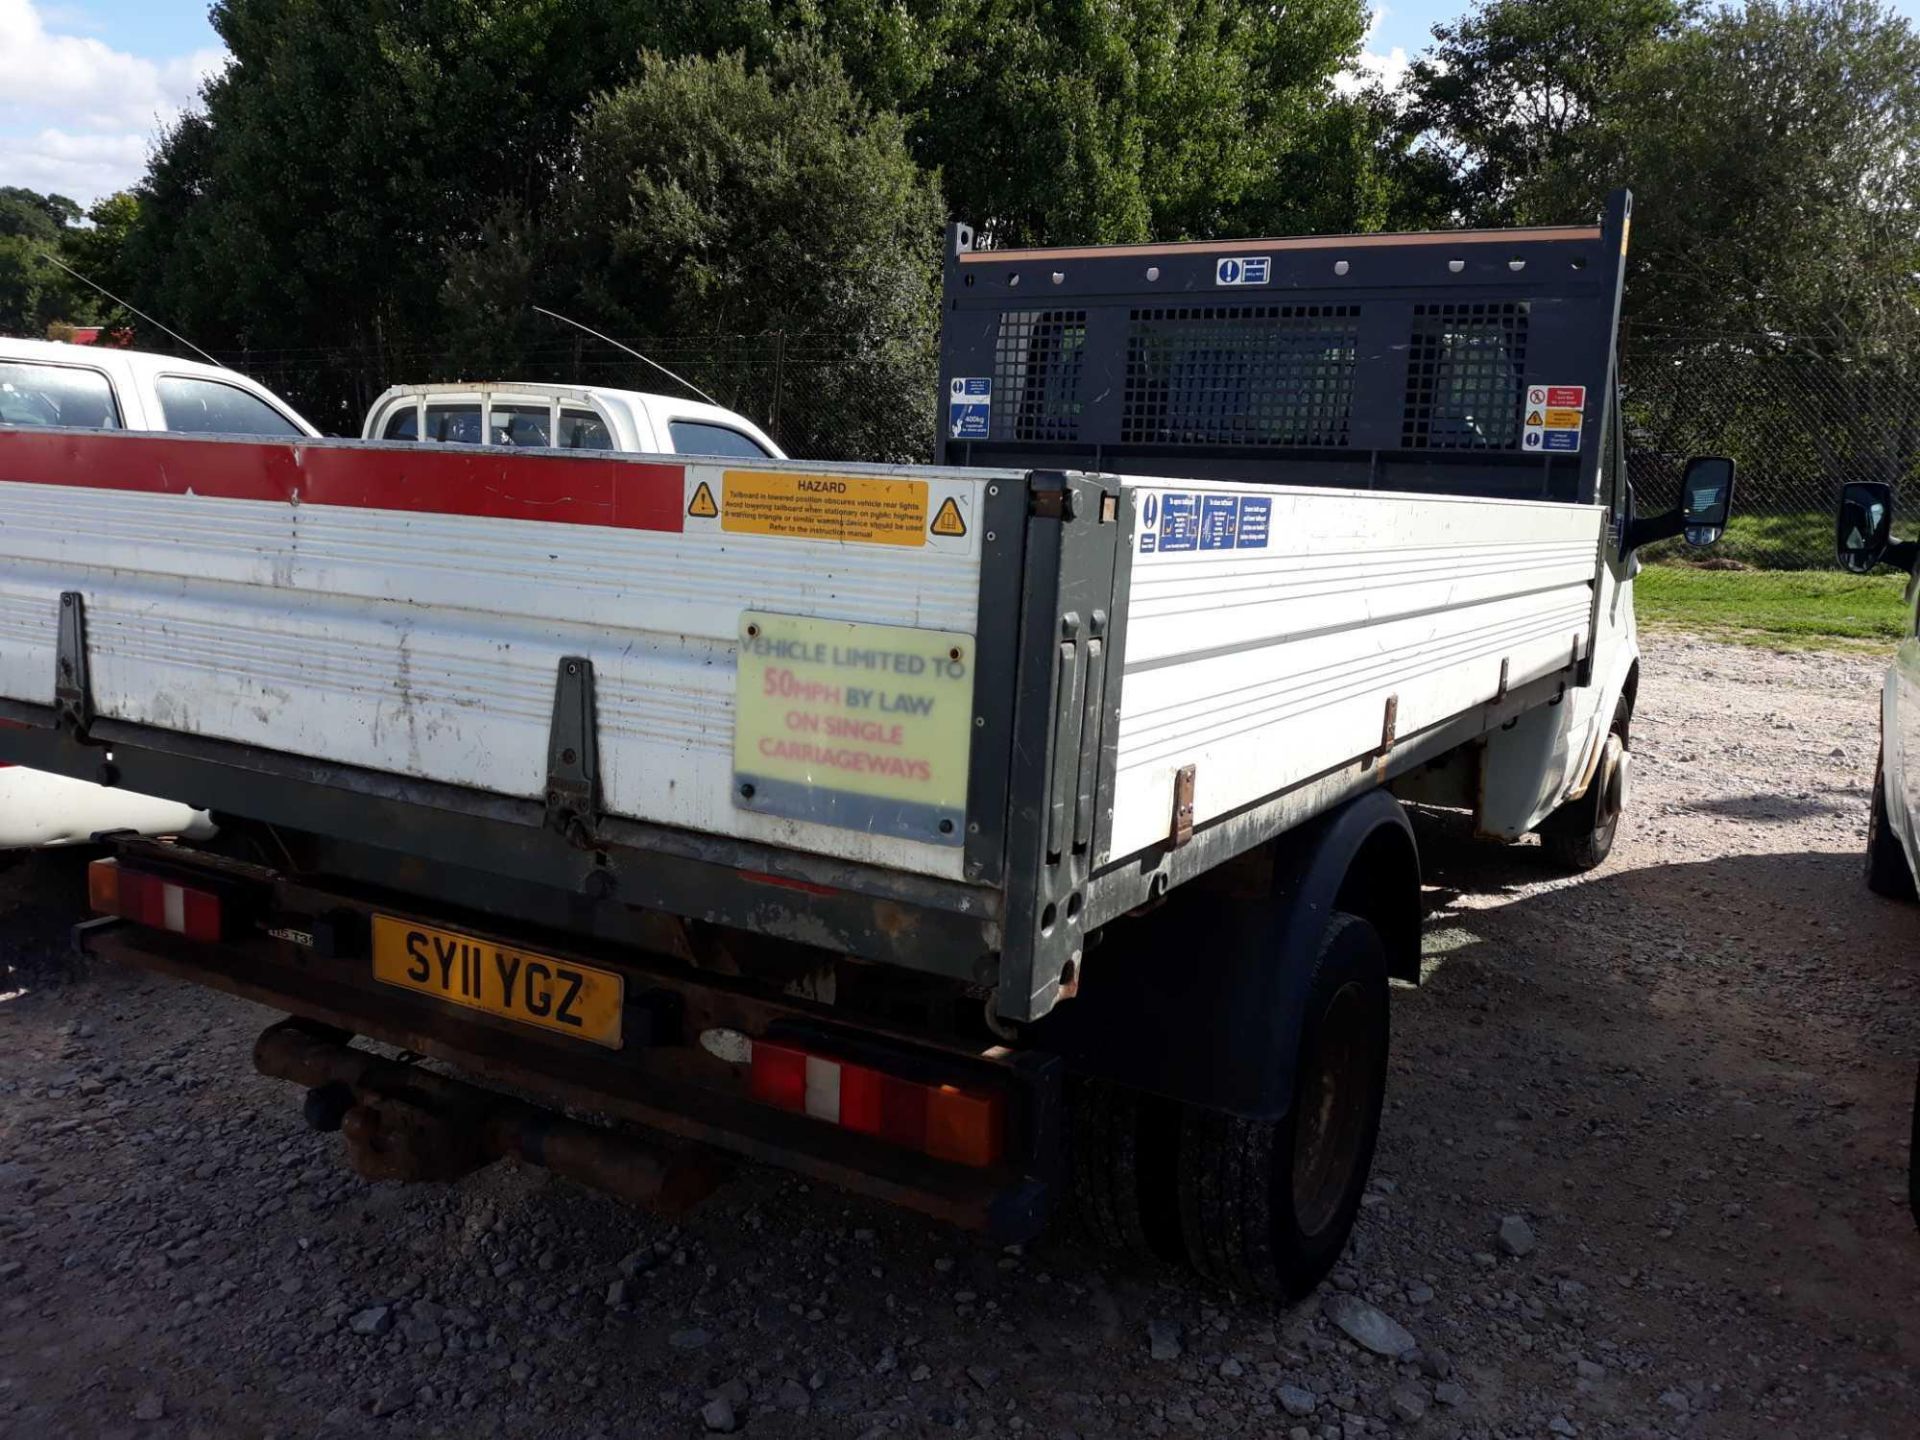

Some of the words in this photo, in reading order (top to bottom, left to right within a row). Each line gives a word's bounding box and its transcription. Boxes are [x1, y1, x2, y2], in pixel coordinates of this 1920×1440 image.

[797, 479, 847, 494] HAZARD
[740, 635, 826, 664] VEHICLE
[832, 646, 925, 675] LIMITED
[932, 657, 966, 680] TO
[763, 666, 842, 706] 50MPH
[846, 687, 873, 708] BY
[879, 691, 935, 717] LAW
[786, 710, 818, 733] ON
[824, 715, 904, 745] SINGLE
[758, 737, 931, 781] CARRIAGEWAYS
[406, 931, 481, 999] SY11
[495, 953, 584, 1027] YGZ
